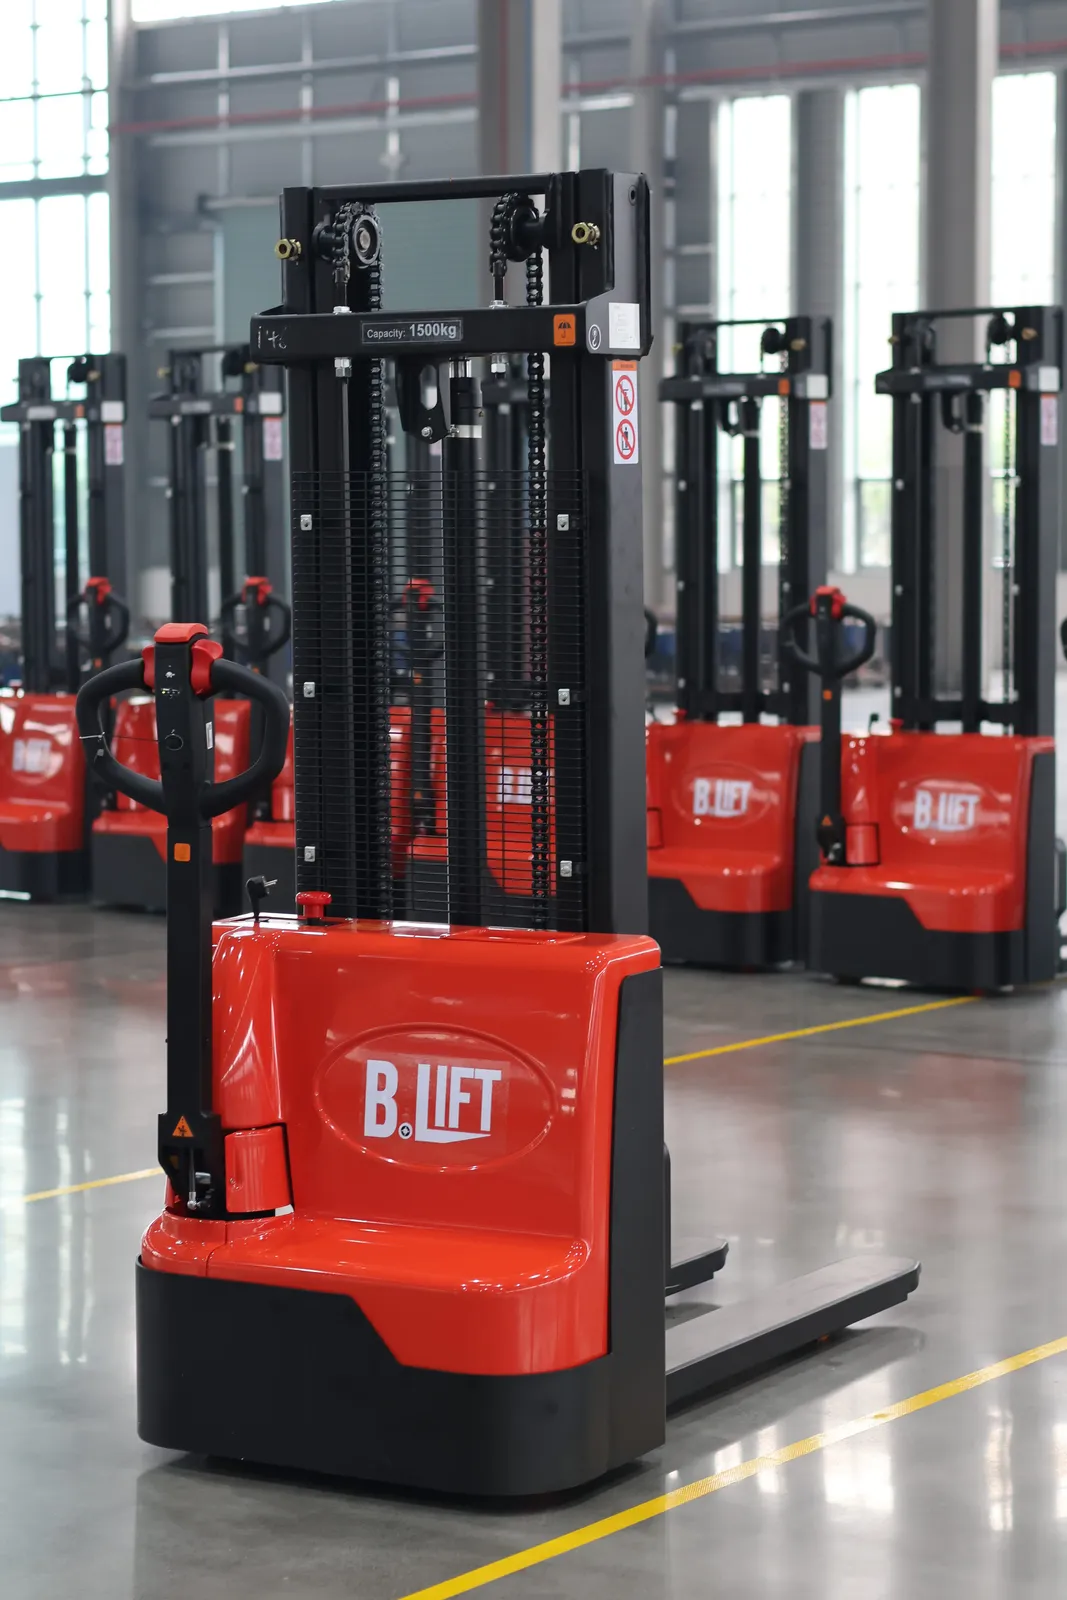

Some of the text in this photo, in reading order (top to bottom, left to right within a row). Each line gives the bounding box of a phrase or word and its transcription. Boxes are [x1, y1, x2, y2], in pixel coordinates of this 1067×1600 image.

[367, 323, 457, 339] Capacity: 1500kg
[364, 1059, 502, 1143] B.LIFT
